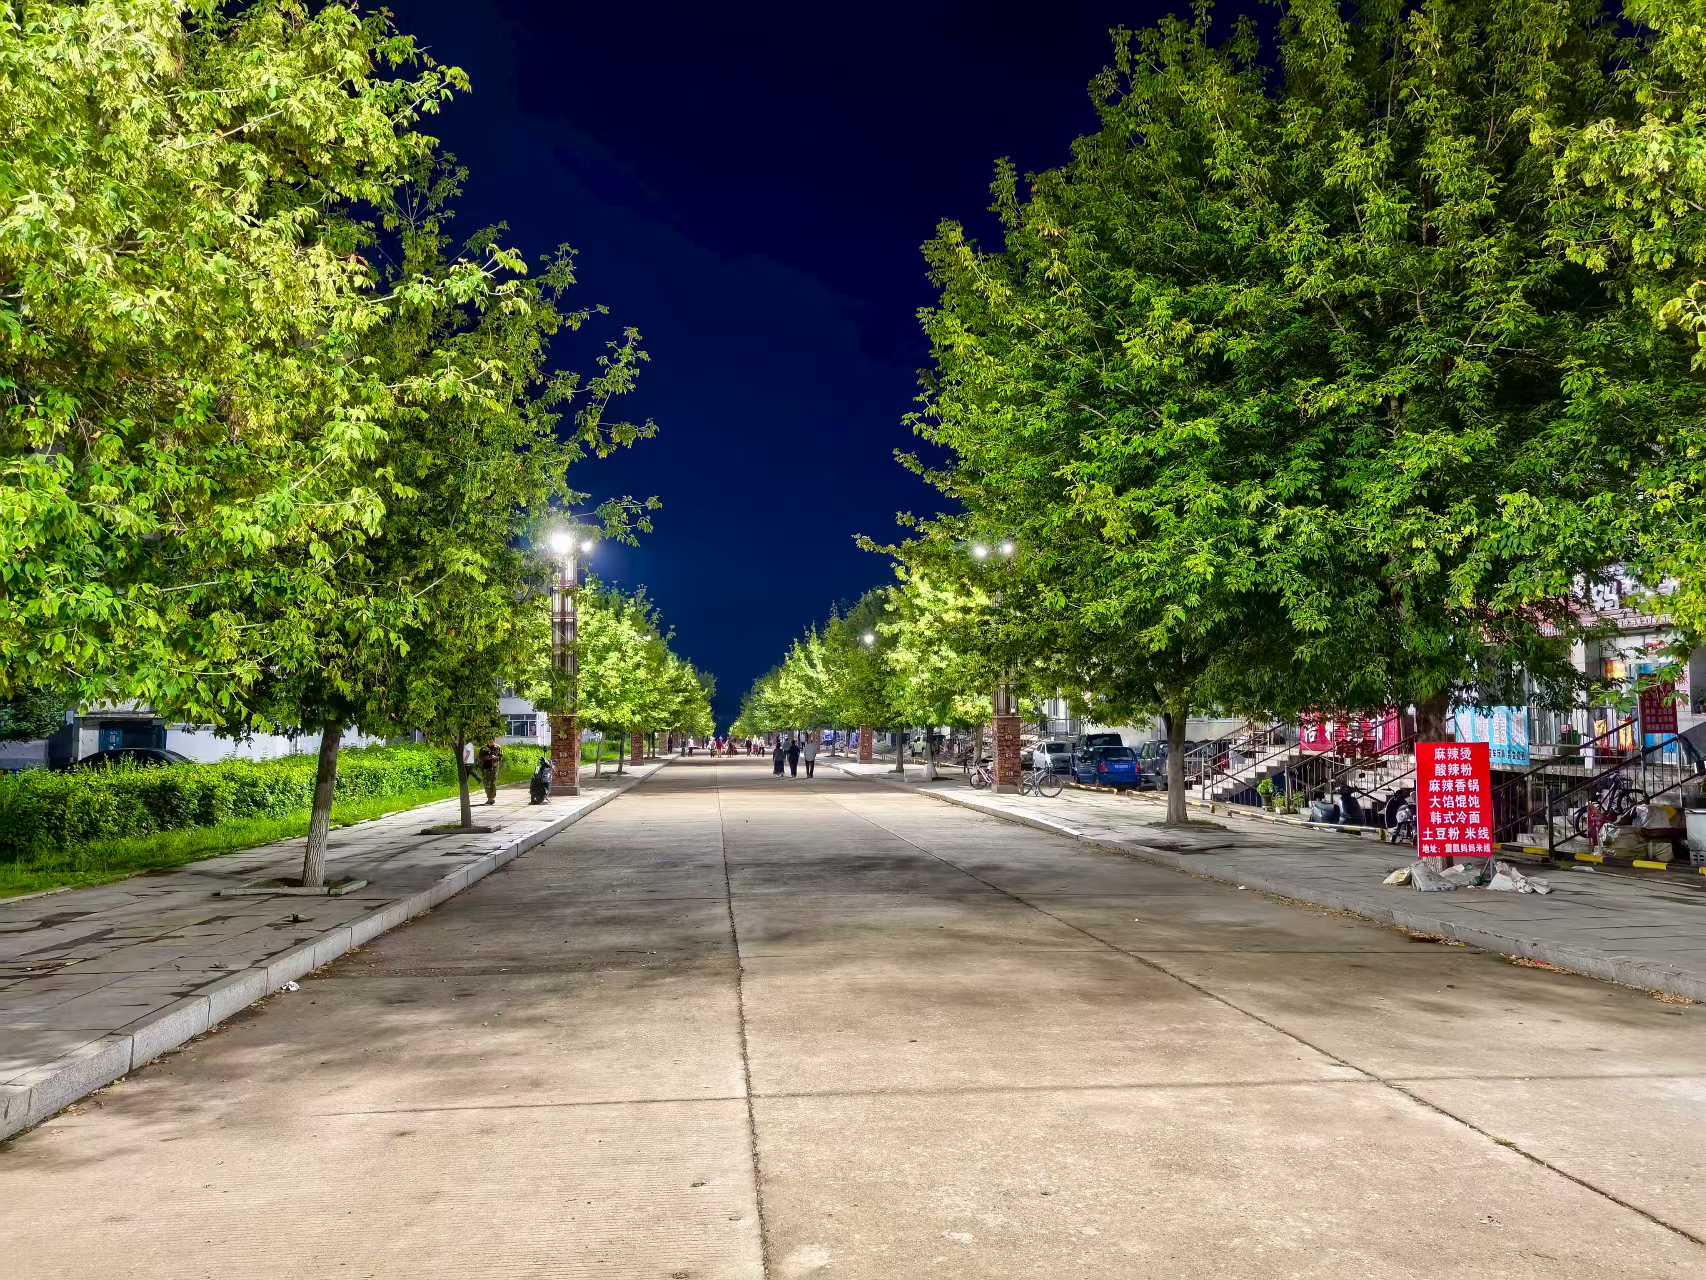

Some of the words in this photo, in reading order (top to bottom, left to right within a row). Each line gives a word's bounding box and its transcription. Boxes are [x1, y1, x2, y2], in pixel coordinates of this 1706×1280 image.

[1434, 747, 1472, 760] 麻辣烫
[1434, 763, 1472, 776] 酸辣粉
[1429, 779, 1480, 792] 麻辣香锅
[1429, 795, 1481, 808] 大馅馄饨
[1430, 811, 1480, 824] 韩式冷面
[1422, 827, 1460, 840] 土豆粉
[1465, 827, 1490, 840] 米线
